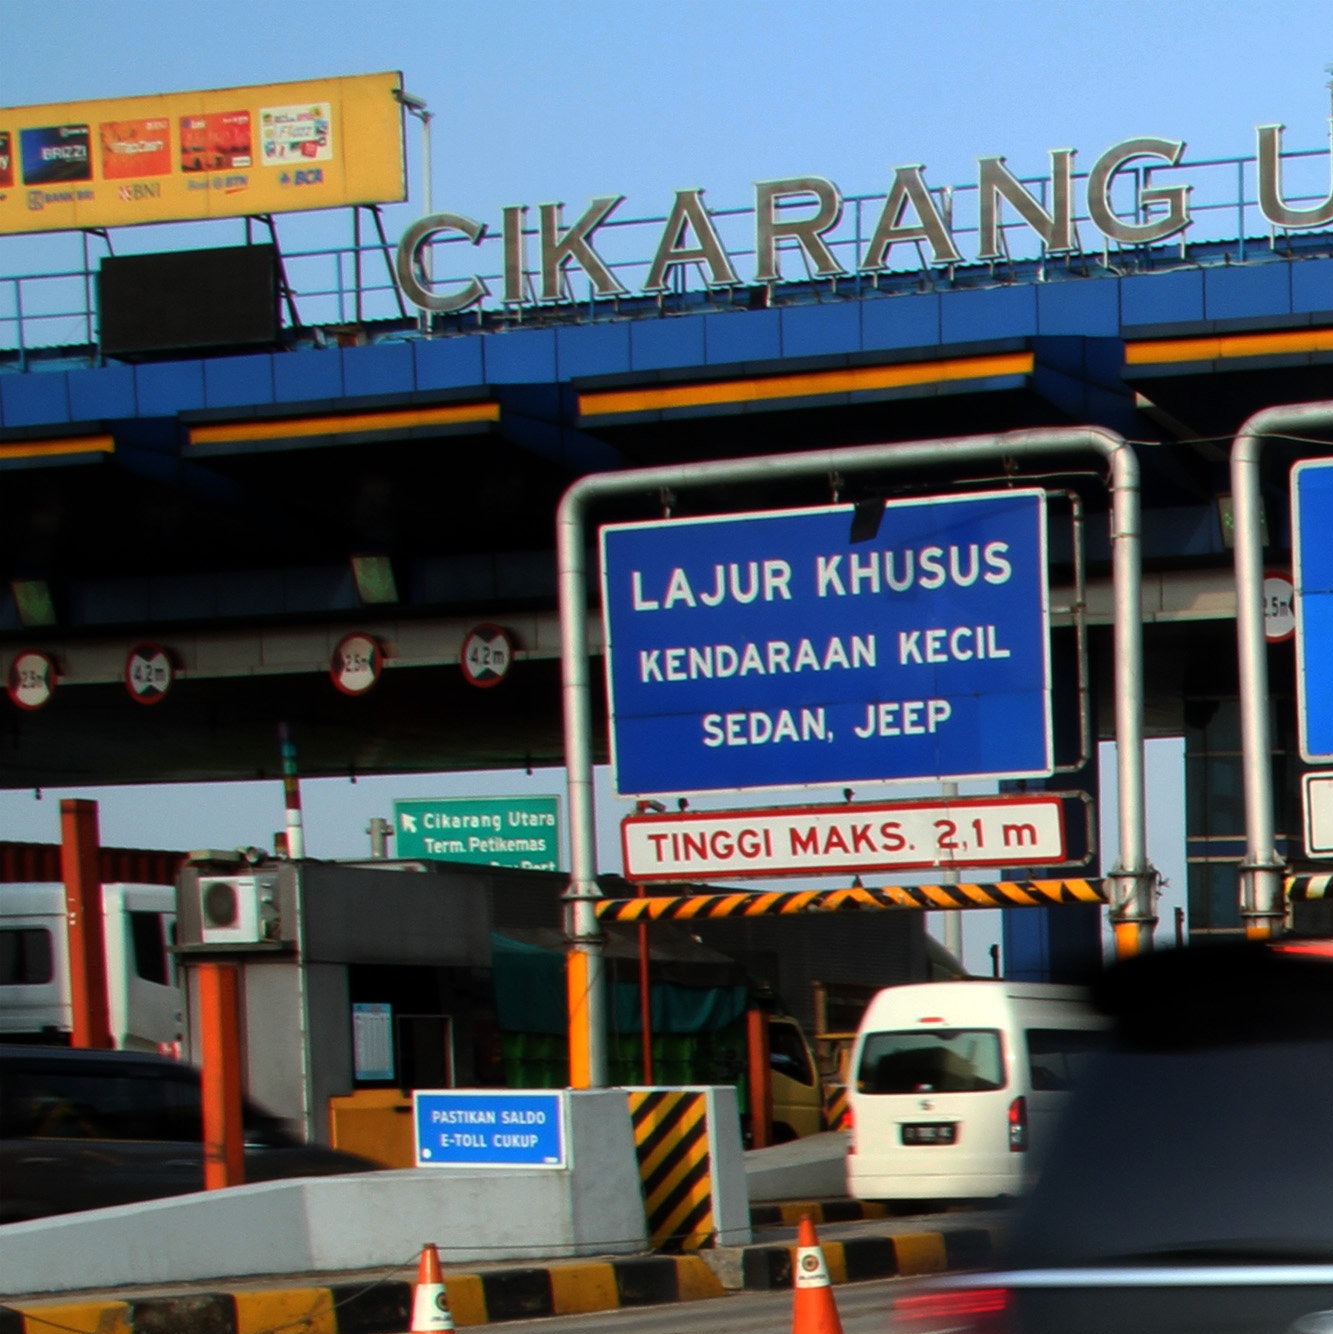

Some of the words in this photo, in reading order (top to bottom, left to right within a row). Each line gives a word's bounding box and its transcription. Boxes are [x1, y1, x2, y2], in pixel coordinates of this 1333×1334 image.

[397, 136, 1194, 312] CIKARANG
[631, 559, 791, 611] LAJUR
[816, 541, 1011, 597] KHUSUS
[639, 634, 876, 682] KENDARAAN
[898, 624, 1010, 665] KECIL
[702, 707, 833, 747] SEDAN,
[853, 699, 951, 738] JEEP
[423, 812, 502, 831] Cikarang
[508, 811, 555, 827] Utara
[468, 836, 547, 852] Petikemas
[648, 829, 774, 862] TINGGI
[790, 822, 916, 856] MAKS.
[432, 1110, 496, 1124] PASTIKAN
[501, 1110, 546, 1124] SALDO
[440, 1133, 487, 1147] E-TOLL
[493, 1133, 539, 1147] CUKUP
